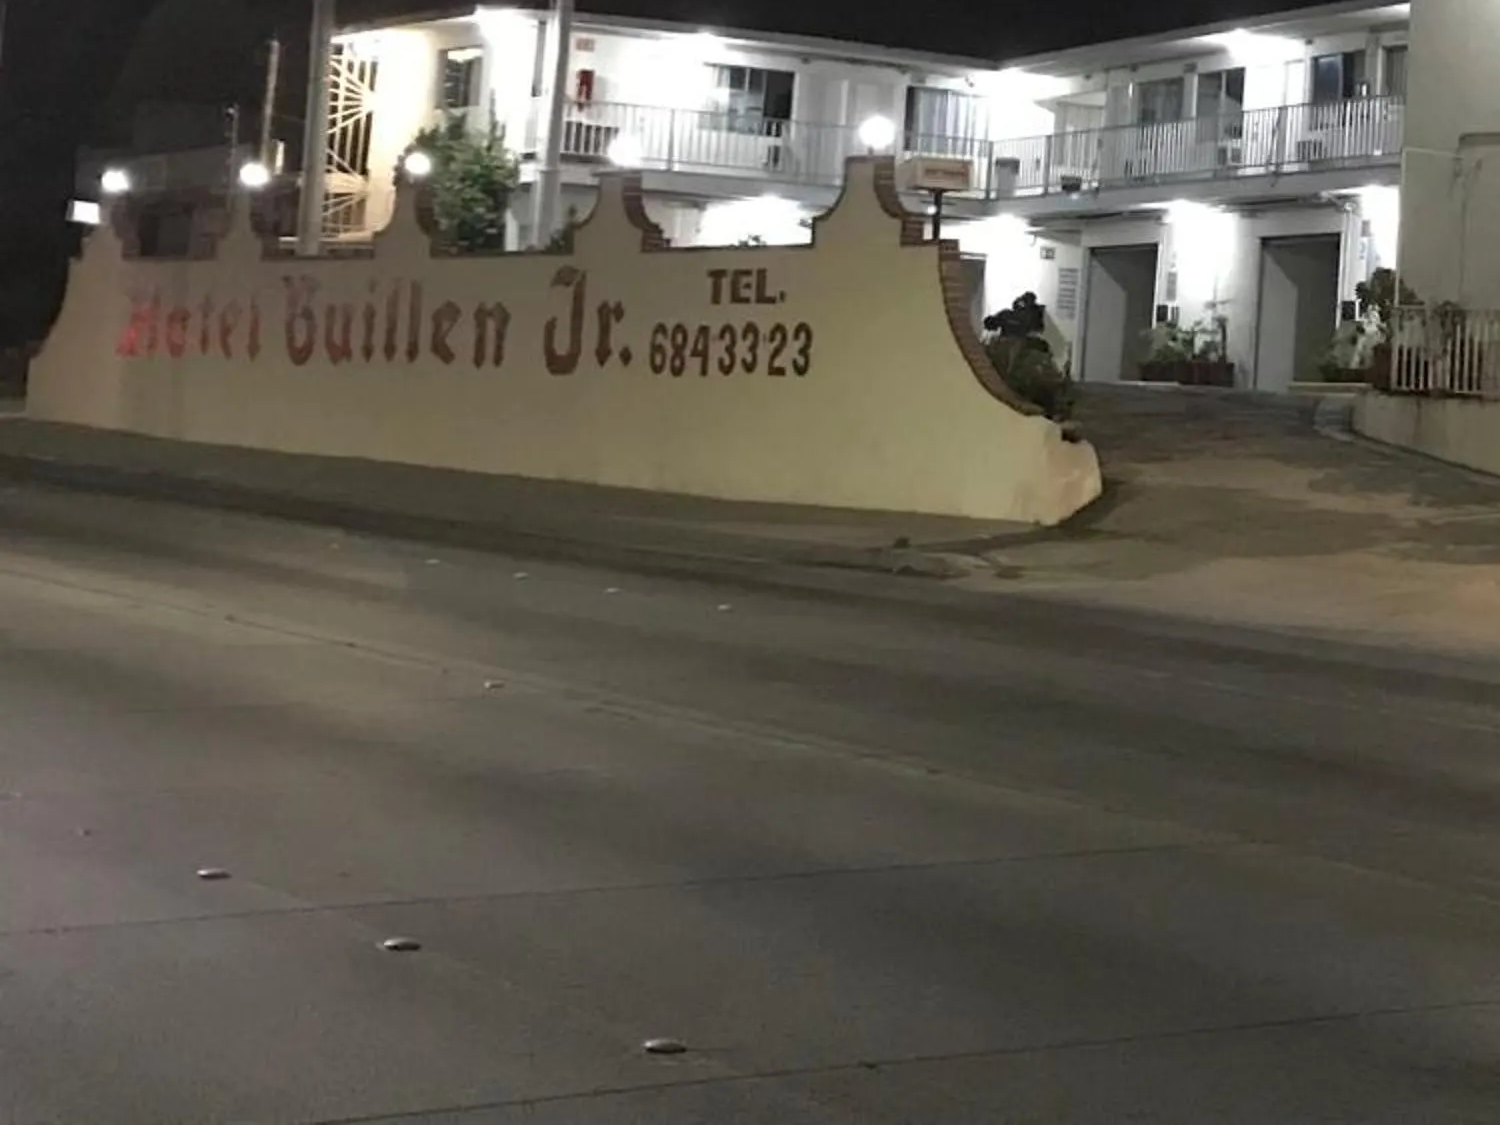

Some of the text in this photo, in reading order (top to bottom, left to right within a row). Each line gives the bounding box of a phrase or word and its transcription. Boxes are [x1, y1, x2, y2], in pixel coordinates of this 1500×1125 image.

[283, 275, 511, 368] Guillen
[542, 265, 633, 376] Jr.
[706, 267, 787, 305] TEL.
